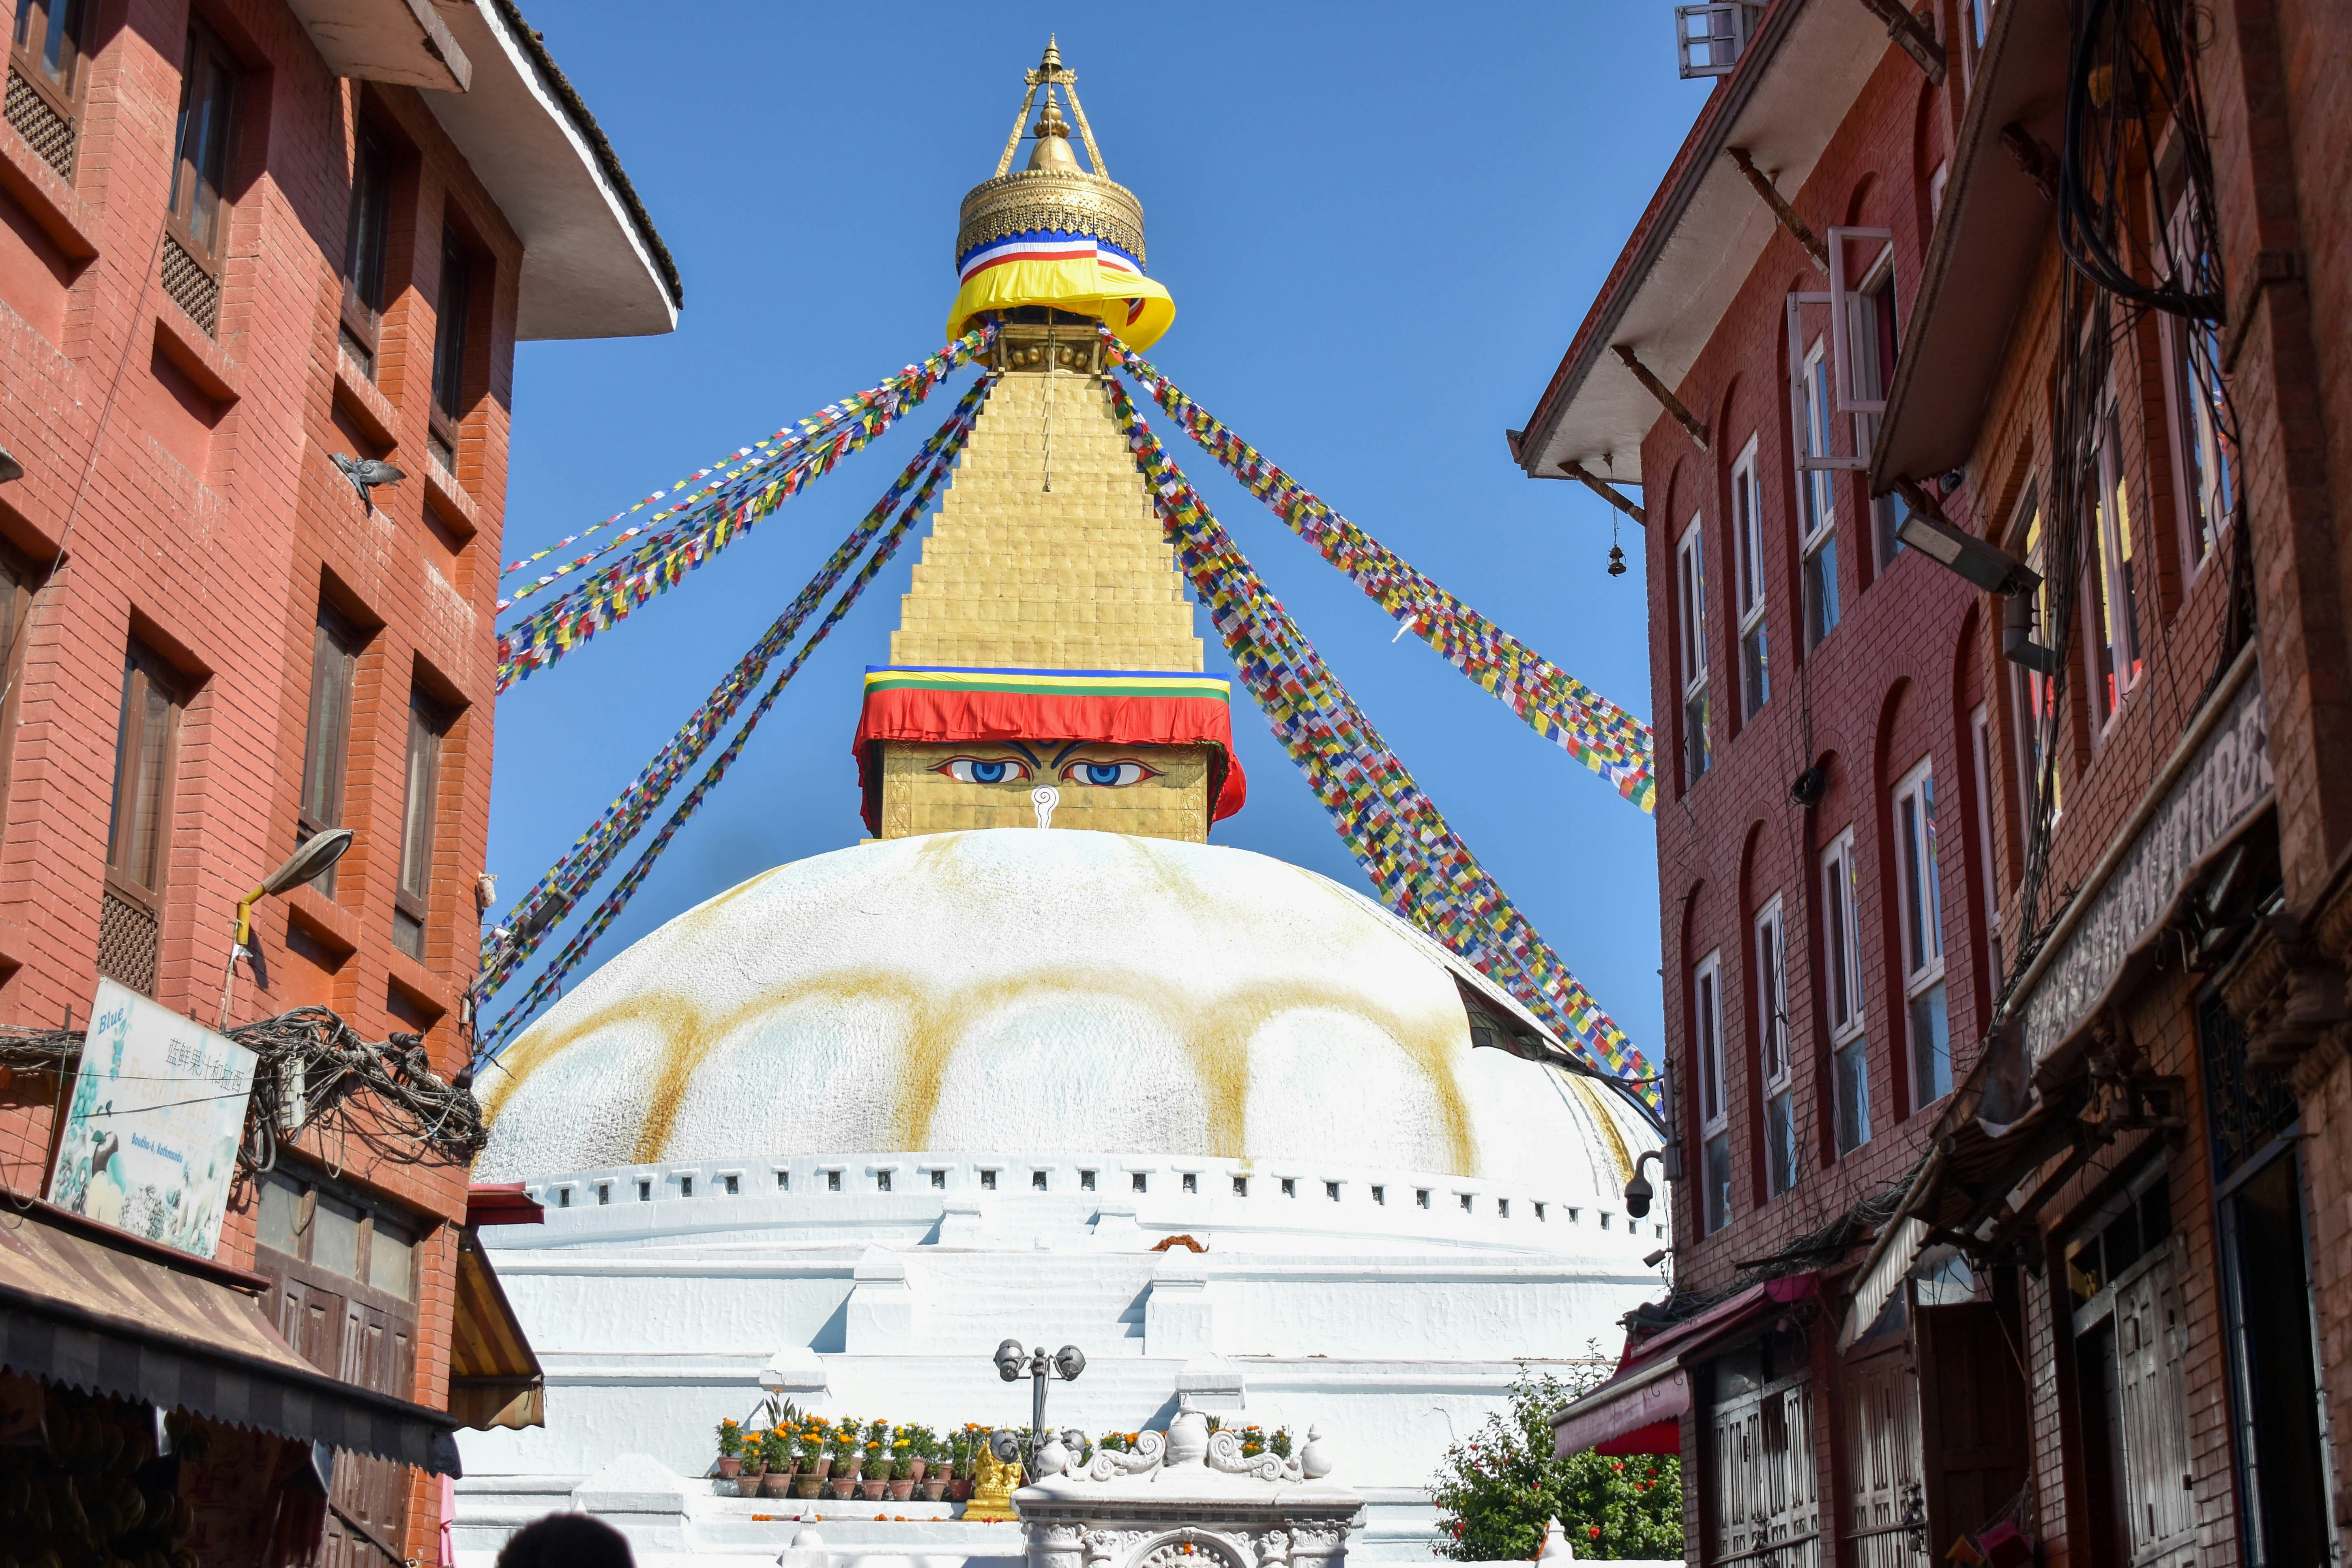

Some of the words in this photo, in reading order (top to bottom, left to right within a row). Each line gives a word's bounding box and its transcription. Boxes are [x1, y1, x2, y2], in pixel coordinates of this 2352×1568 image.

[98, 1007, 124, 1035] Blue
[123, 1056, 168, 1104] Fresh
[166, 1038, 244, 1093] 蓝鲜果汁和拉西
[131, 1132, 156, 1154] Boudha-6,
[157, 1142, 183, 1163] Kathmandu
